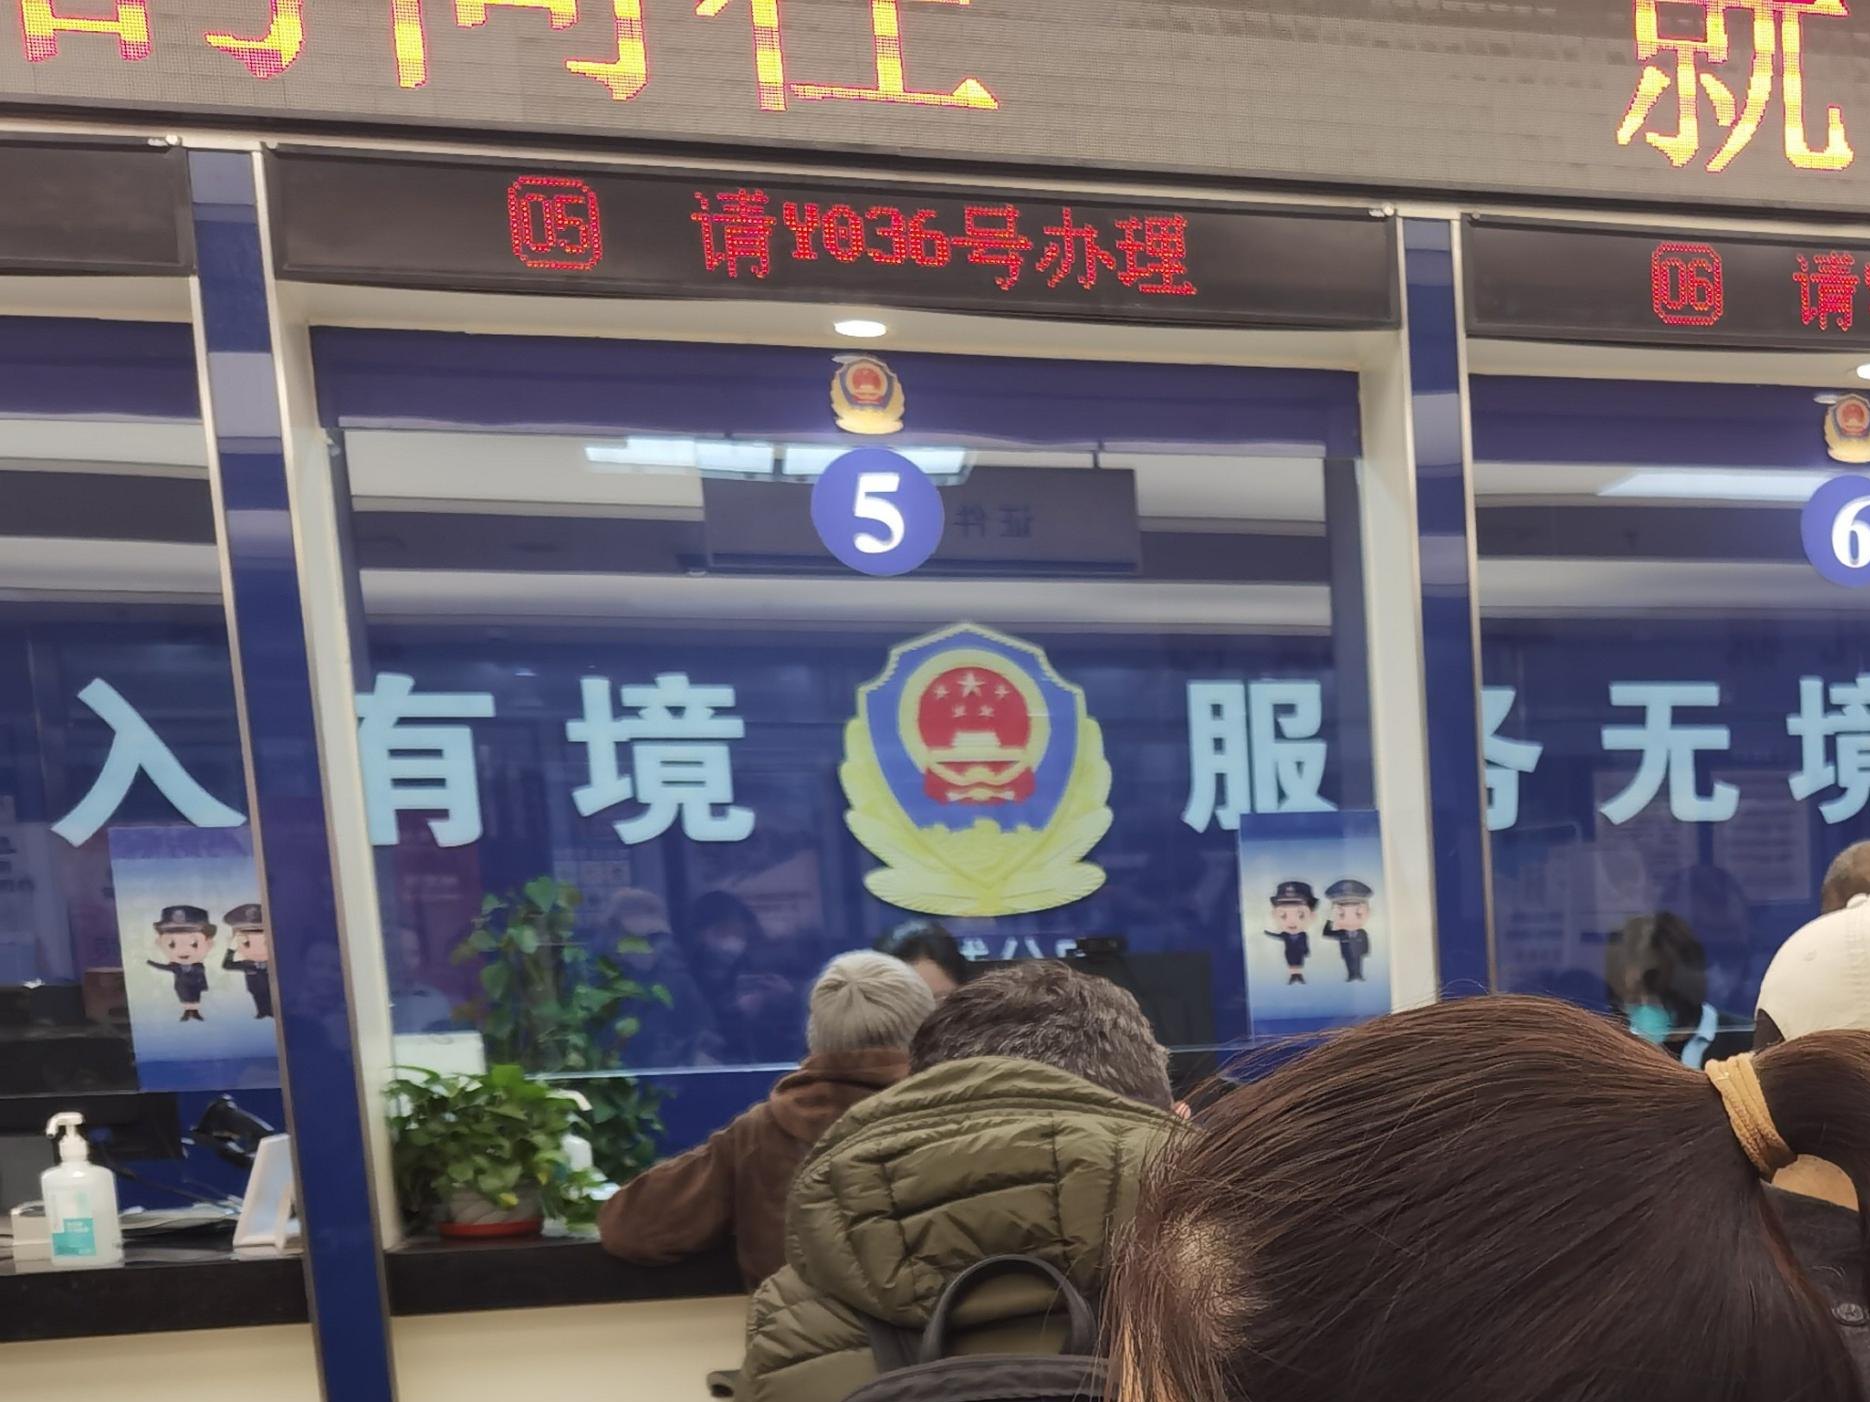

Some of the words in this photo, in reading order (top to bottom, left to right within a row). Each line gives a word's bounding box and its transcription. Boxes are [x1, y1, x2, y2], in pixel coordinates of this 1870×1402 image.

[519, 192, 588, 254] 05
[691, 187, 1197, 296] 请Y036号办理
[1661, 258, 1716, 310] 06
[853, 472, 905, 554] 5
